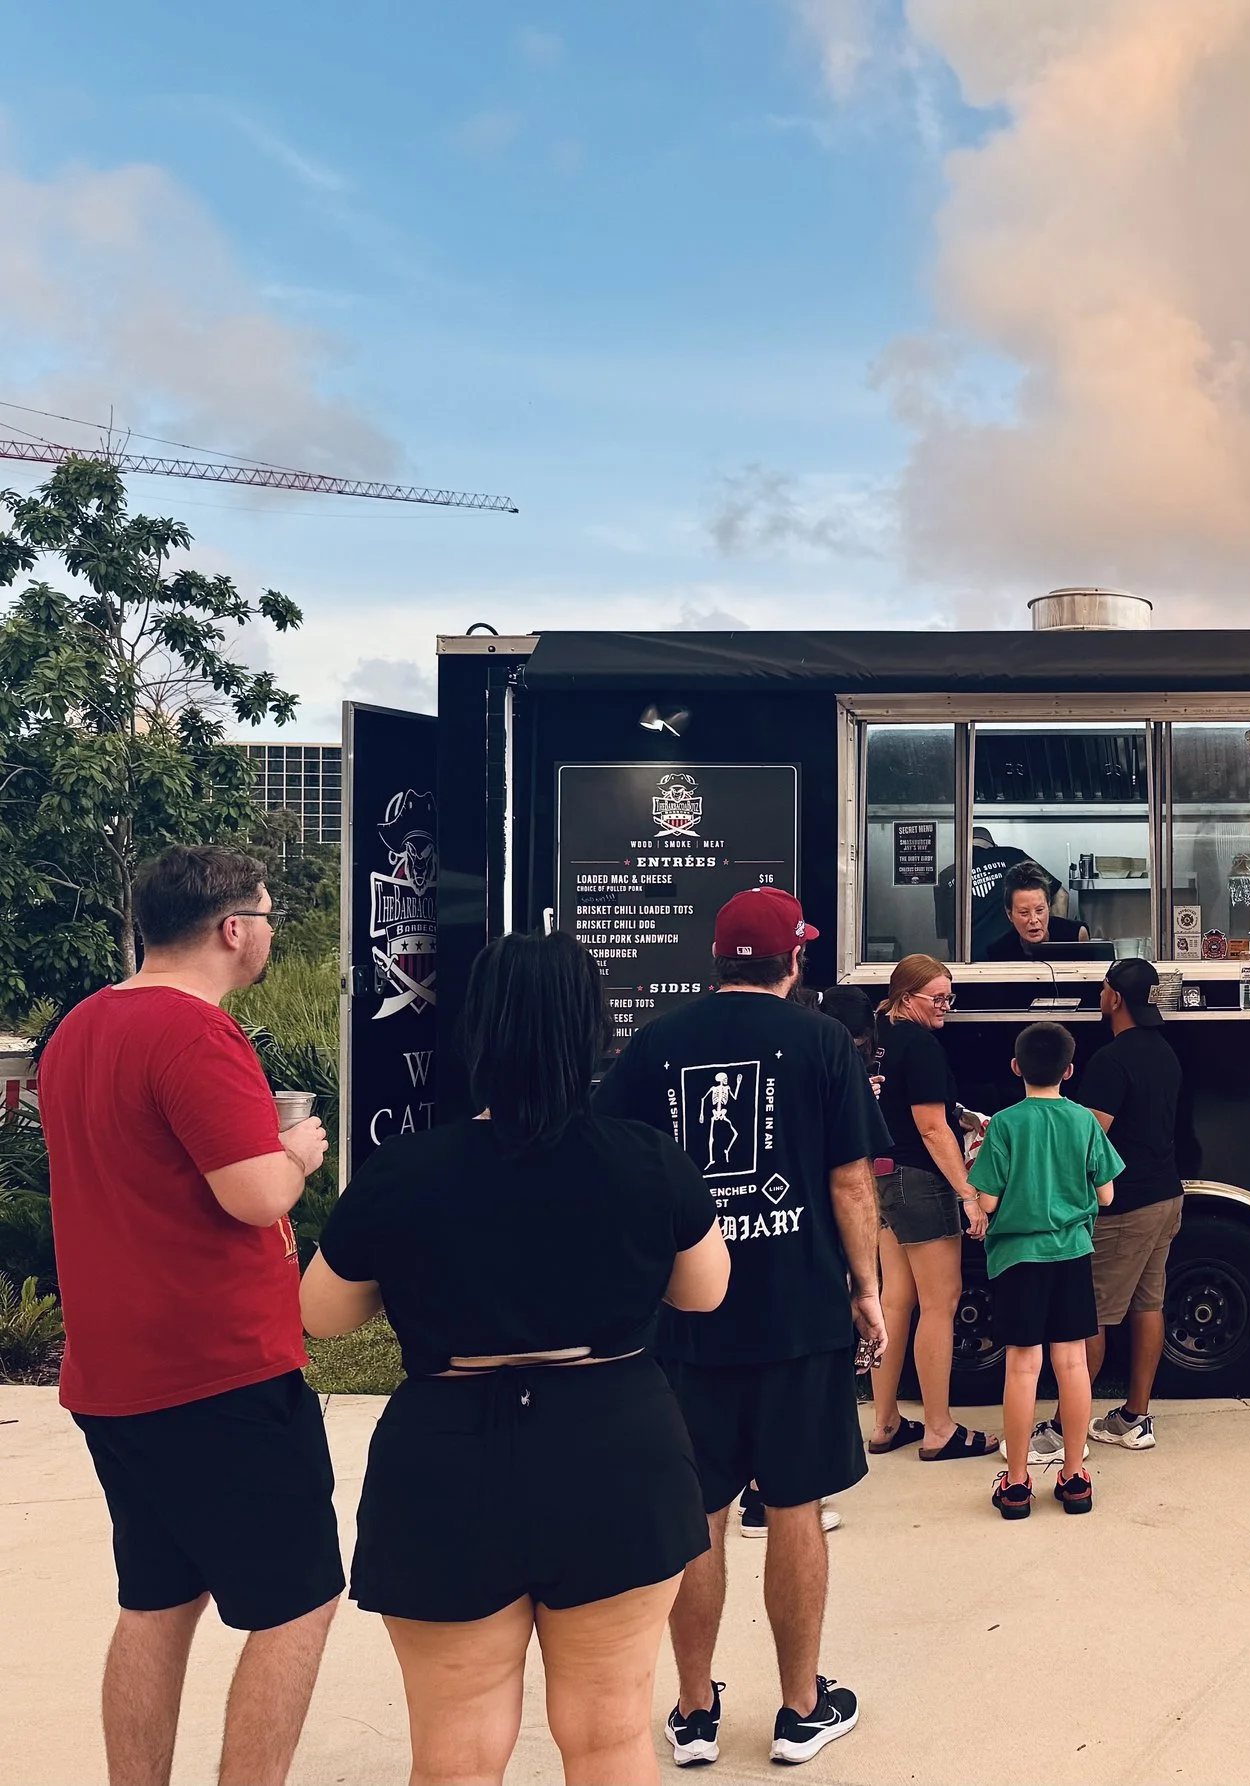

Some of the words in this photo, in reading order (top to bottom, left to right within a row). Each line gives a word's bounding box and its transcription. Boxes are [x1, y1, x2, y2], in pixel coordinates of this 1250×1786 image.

[898, 826, 918, 835] SECRET
[630, 840, 653, 848] WOOD
[664, 840, 691, 848] SMOKE
[703, 840, 725, 848] MEAT
[636, 855, 717, 867] ENTRÉES
[982, 861, 1007, 871] SOUTH
[576, 874, 609, 884] LOADED
[611, 874, 629, 884] MAC
[631, 875, 638, 884] &
[640, 874, 673, 884] CHEESE
[758, 873, 774, 884] $16
[375, 881, 437, 923] THEBARBACO
[576, 905, 612, 915] BRISKET
[614, 905, 636, 915] CHILI
[639, 905, 671, 915] LOADED
[673, 905, 694, 915] TOTS
[576, 920, 612, 930] BRISKET
[614, 920, 636, 930] CHILI
[639, 920, 656, 929] DOG
[576, 934, 607, 944] PULLED
[609, 934, 632, 944] PORK
[634, 934, 679, 943] SANDWICH
[649, 983, 701, 993] SIDES
[609, 999, 633, 1008] FRIED
[635, 999, 655, 1008] TOTS
[612, 1013, 634, 1023] EESE
[612, 1027, 632, 1037] HILI
[667, 1088, 677, 1106] NO
[765, 1077, 775, 1112] HOPE
[765, 1117, 774, 1130] IN
[764, 1132, 773, 1150] AN
[717, 1206, 805, 1241] DIARY
